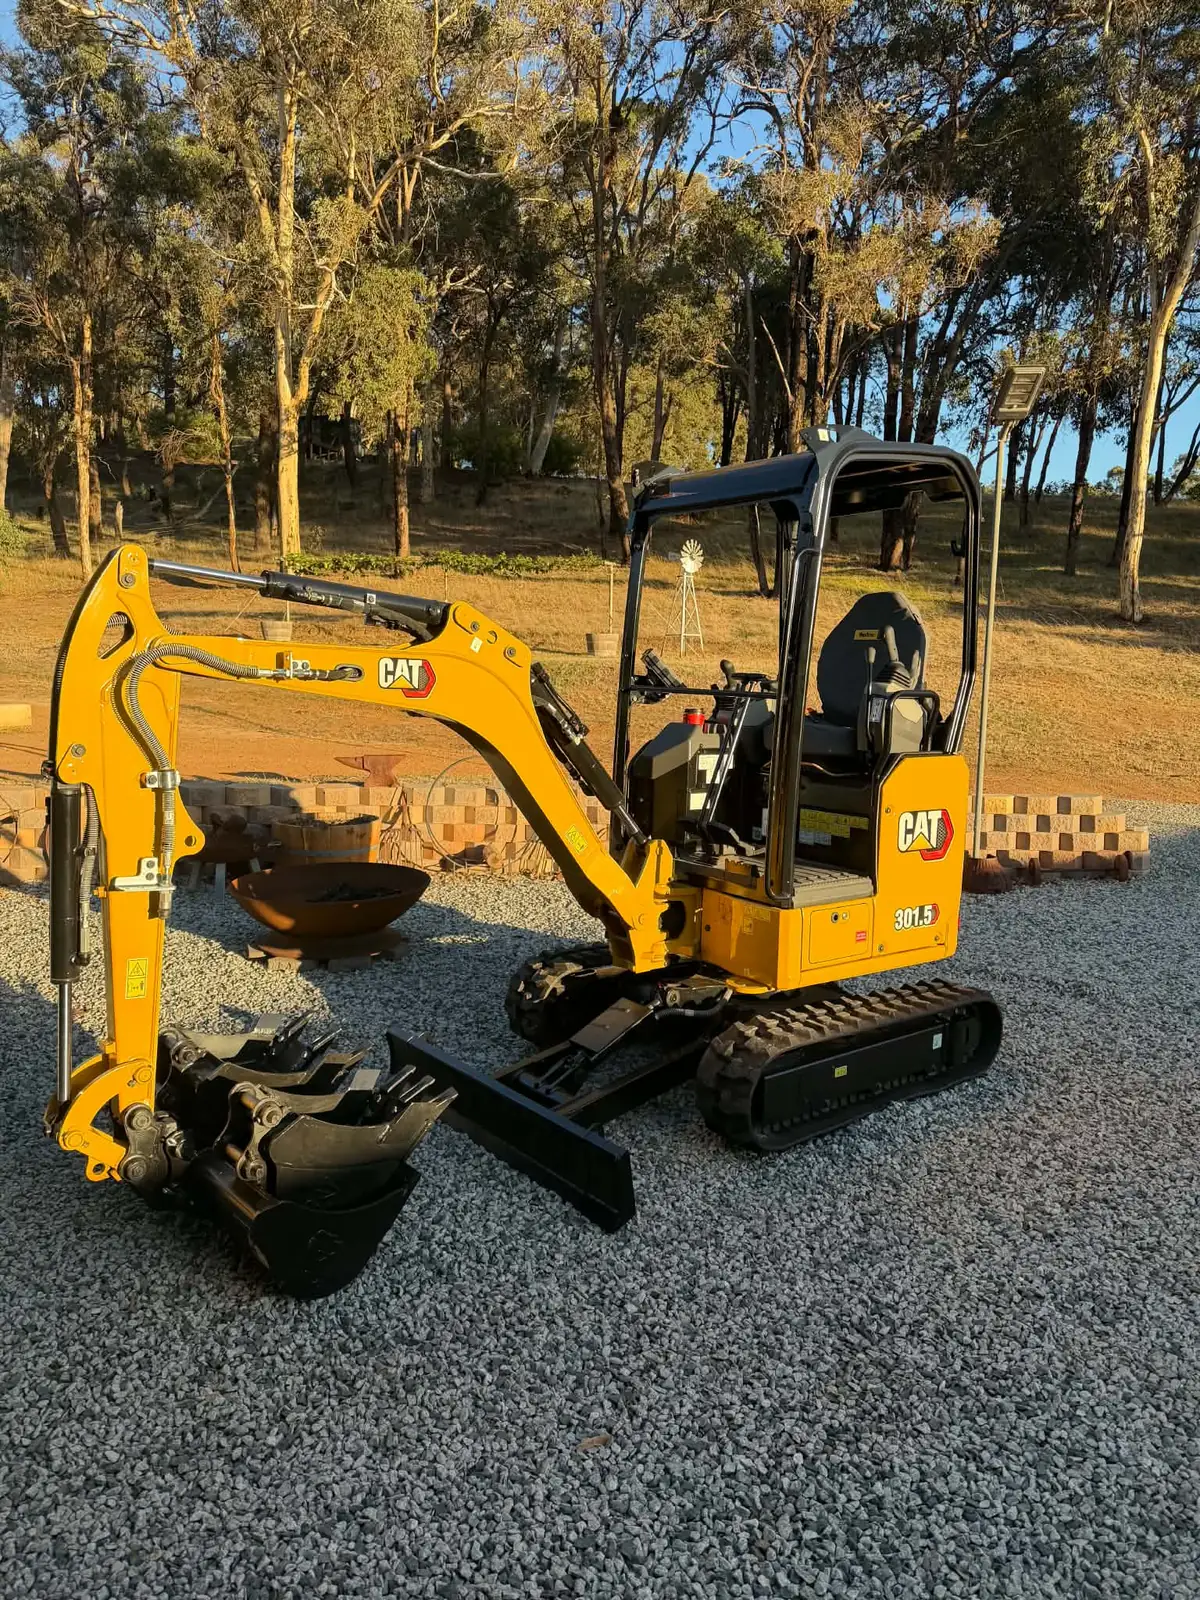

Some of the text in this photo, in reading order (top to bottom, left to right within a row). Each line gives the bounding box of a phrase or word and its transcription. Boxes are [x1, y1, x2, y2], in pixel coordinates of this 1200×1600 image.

[379, 657, 423, 690] CAT
[897, 810, 942, 852] CAT
[894, 904, 933, 930] 301.5
